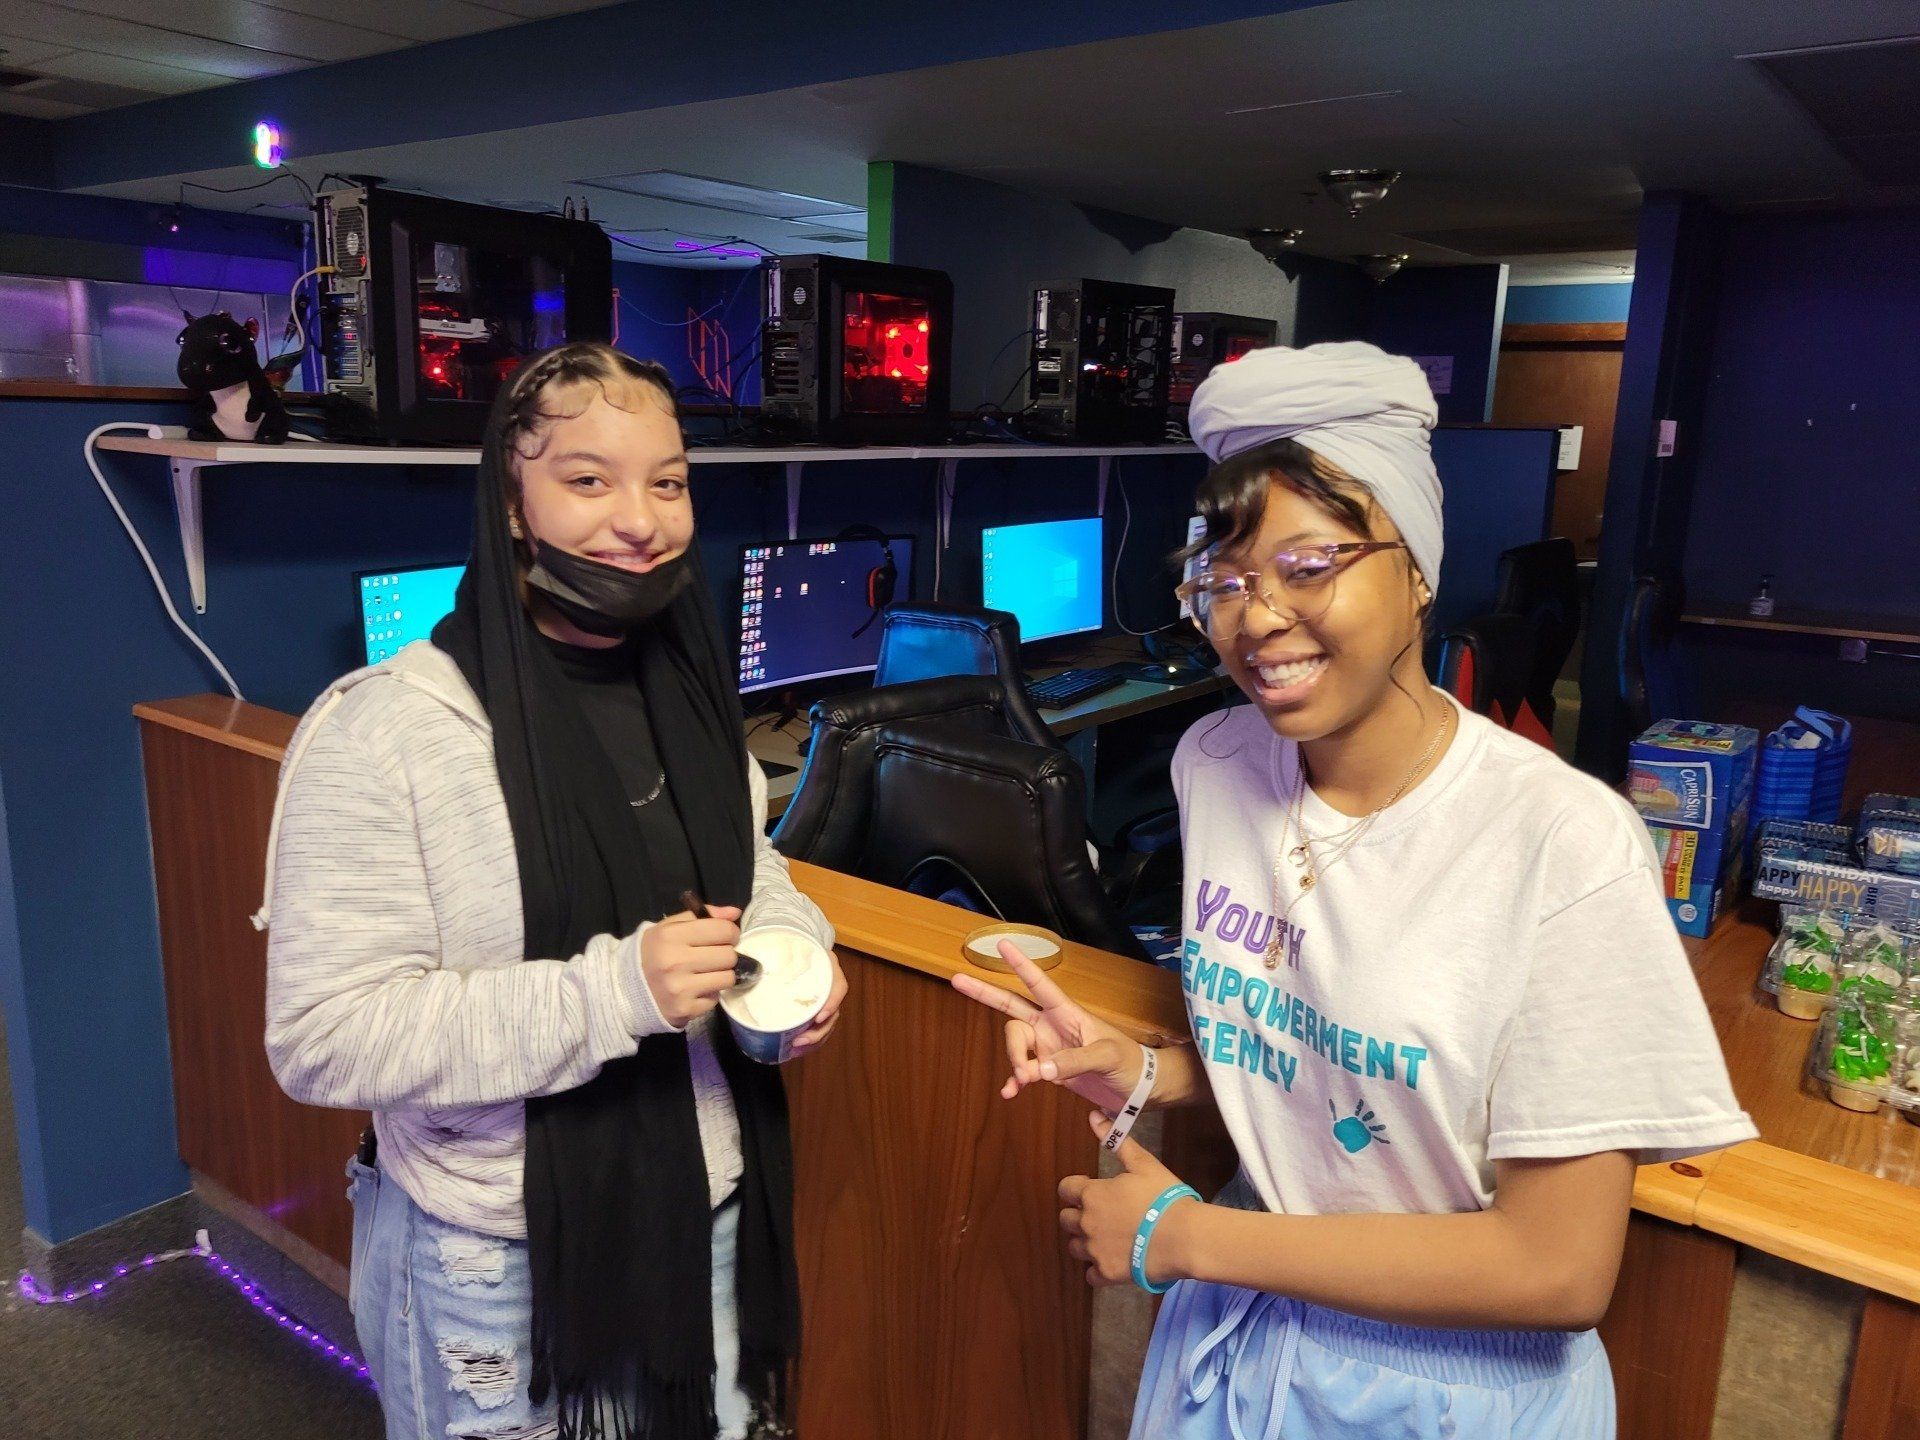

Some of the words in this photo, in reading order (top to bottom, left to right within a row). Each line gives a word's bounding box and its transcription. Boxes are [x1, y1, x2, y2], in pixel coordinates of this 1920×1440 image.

[1796, 859, 1880, 885] BIRTHDAY
[1758, 880, 1799, 898] happy
[1799, 874, 1866, 909] HAPPY
[1181, 938, 1428, 1091] EMPOWERMENT
